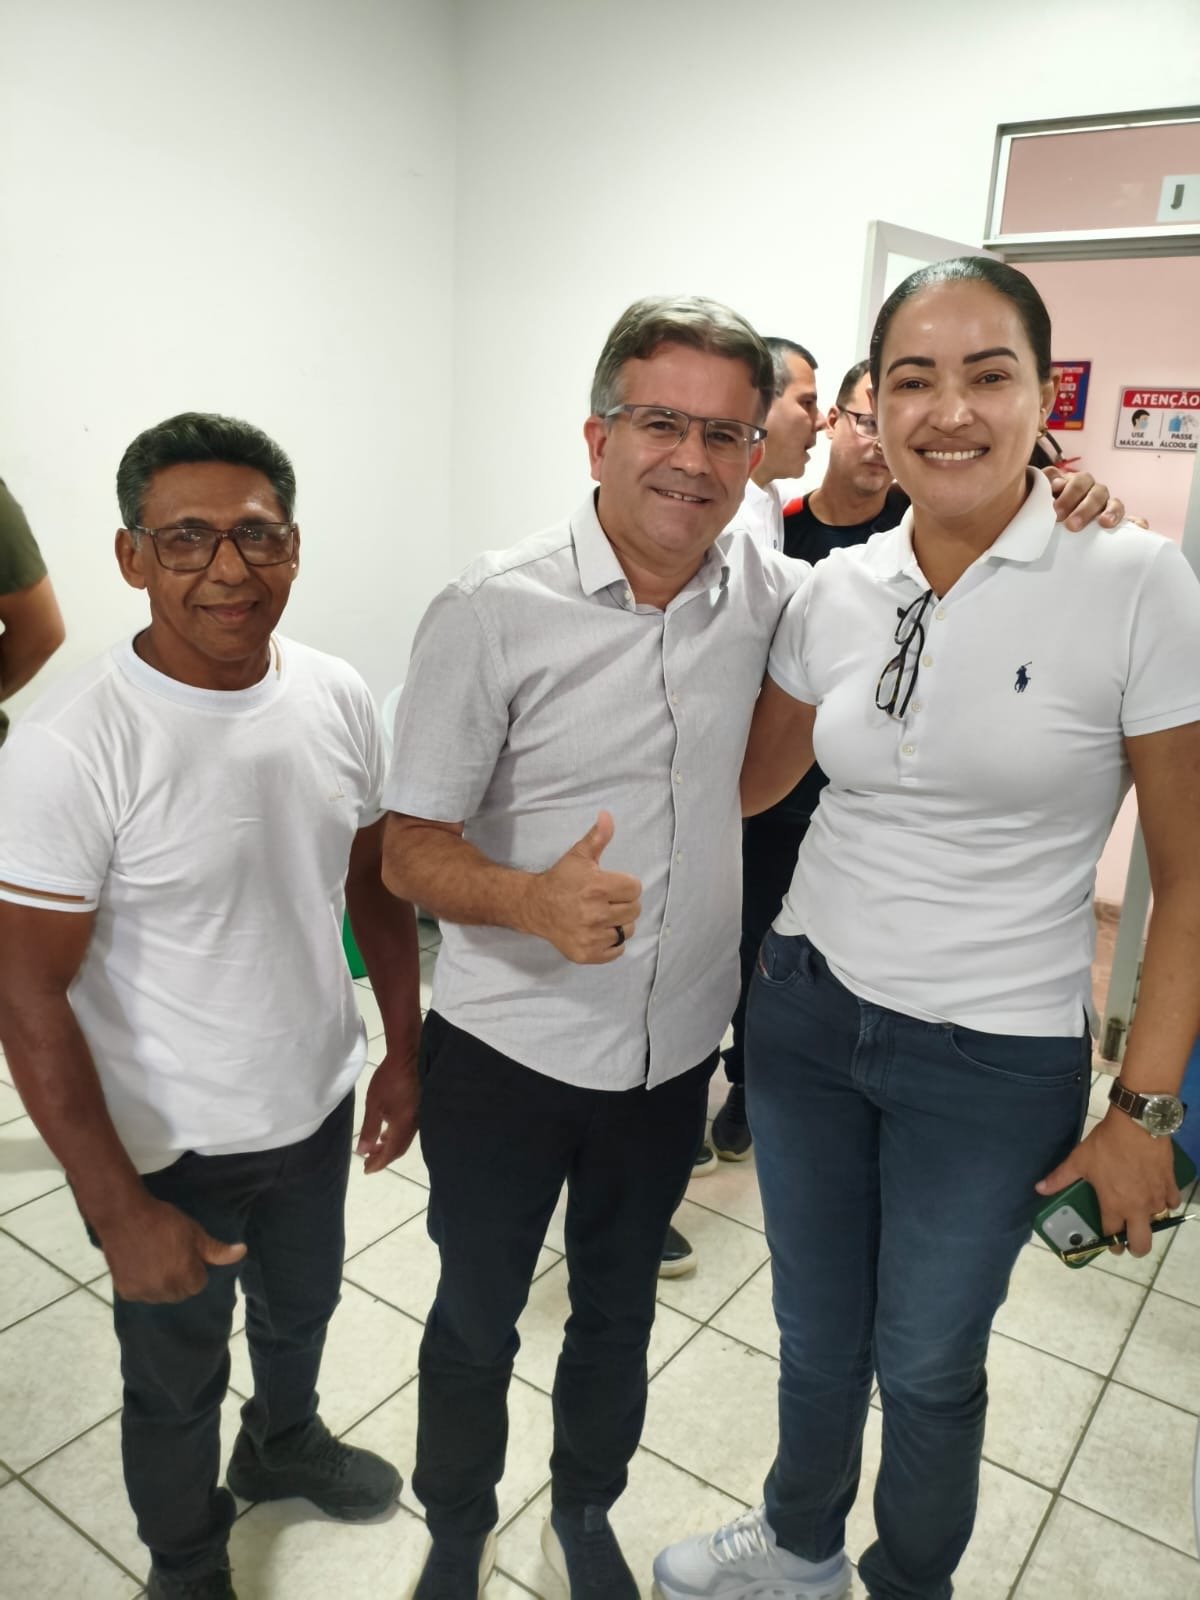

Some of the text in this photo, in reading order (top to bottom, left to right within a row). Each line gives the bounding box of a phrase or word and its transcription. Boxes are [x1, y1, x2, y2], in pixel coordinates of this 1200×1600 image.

[1170, 184, 1185, 210] J
[1131, 392, 1200, 408] ATENÇÃO
[1159, 441, 1187, 449] ÁLCOOL
